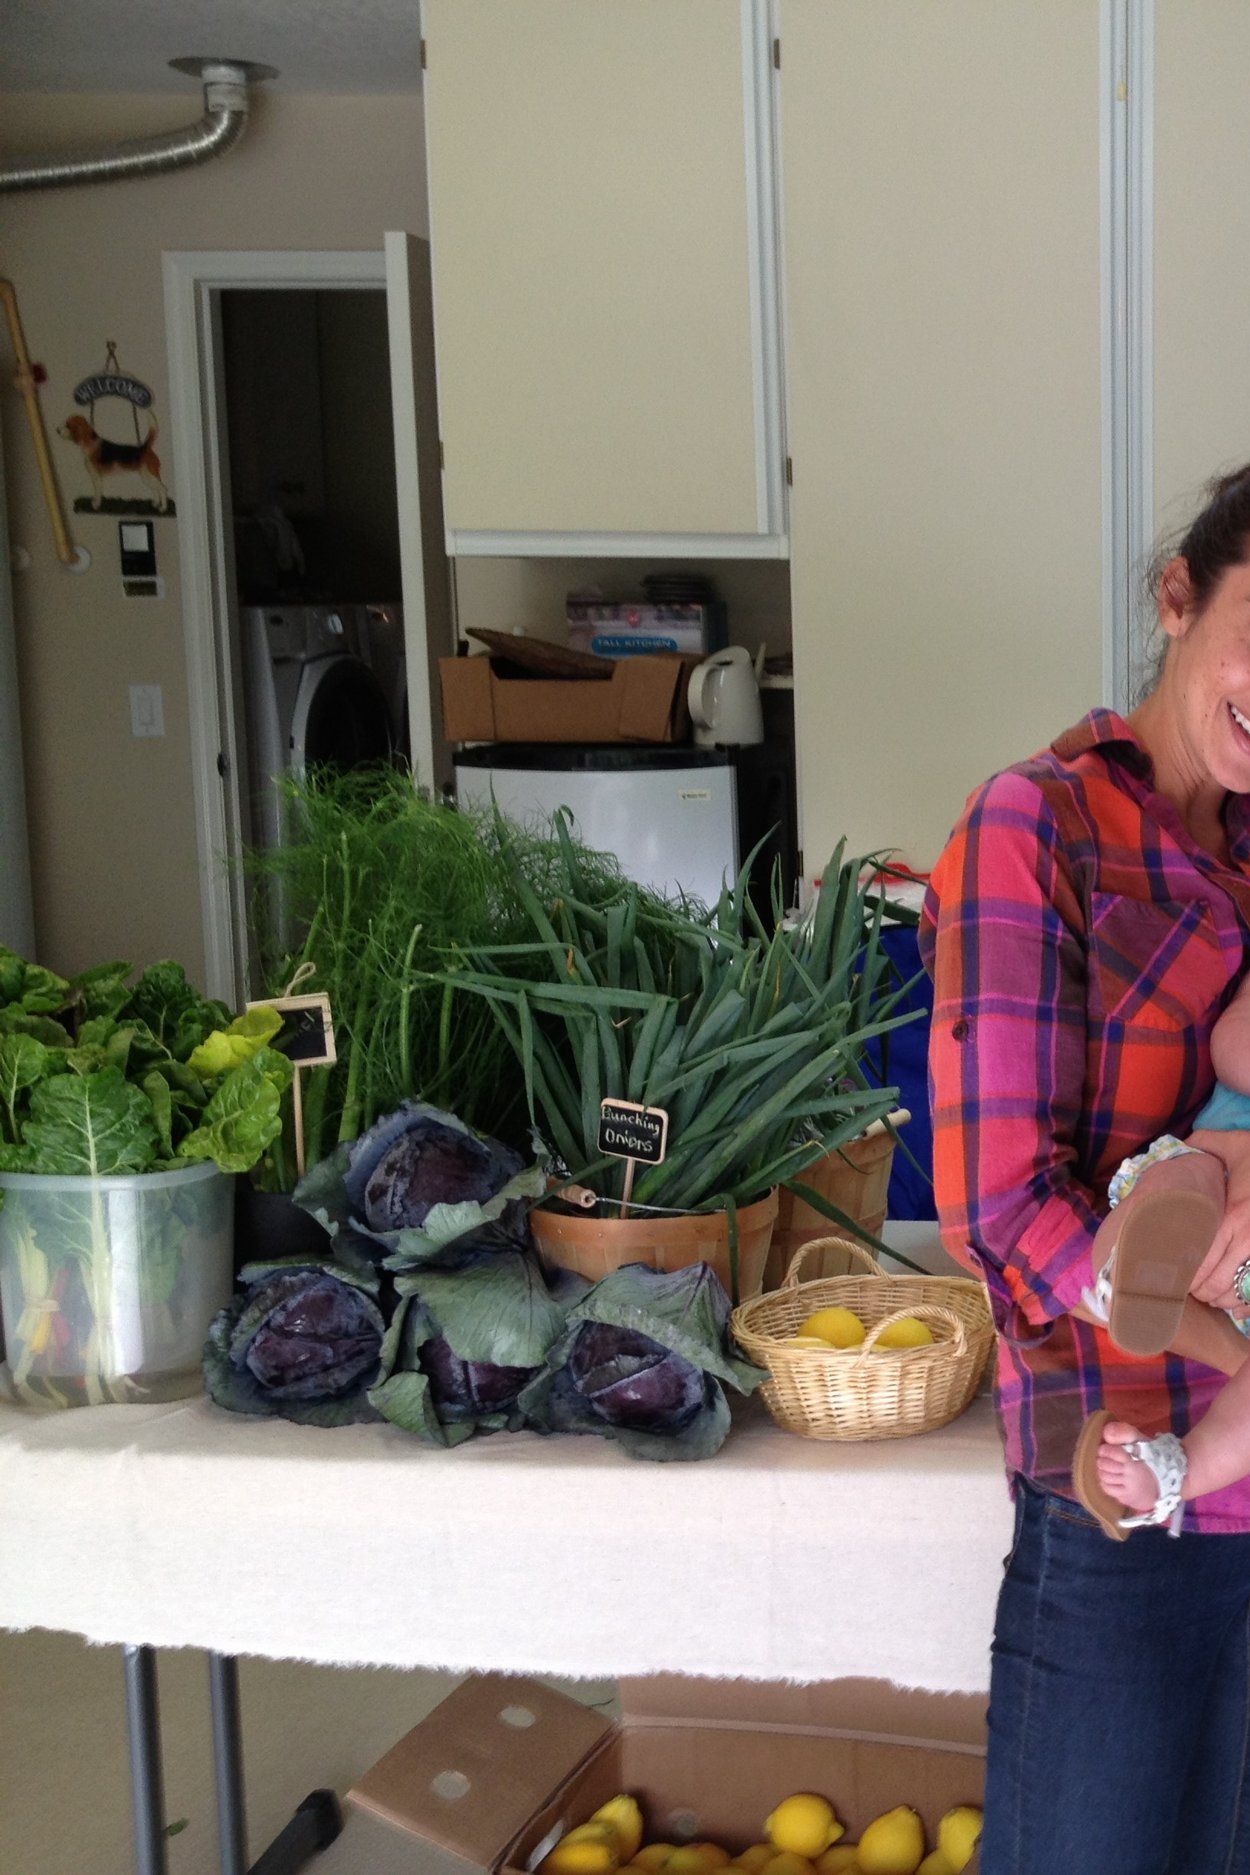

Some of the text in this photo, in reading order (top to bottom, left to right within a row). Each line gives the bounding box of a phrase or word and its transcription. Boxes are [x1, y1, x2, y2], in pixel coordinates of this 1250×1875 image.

[598, 638, 671, 649] TALL KITCHEN
[601, 1106, 660, 1136] Bunching
[605, 1127, 653, 1152] Onions
